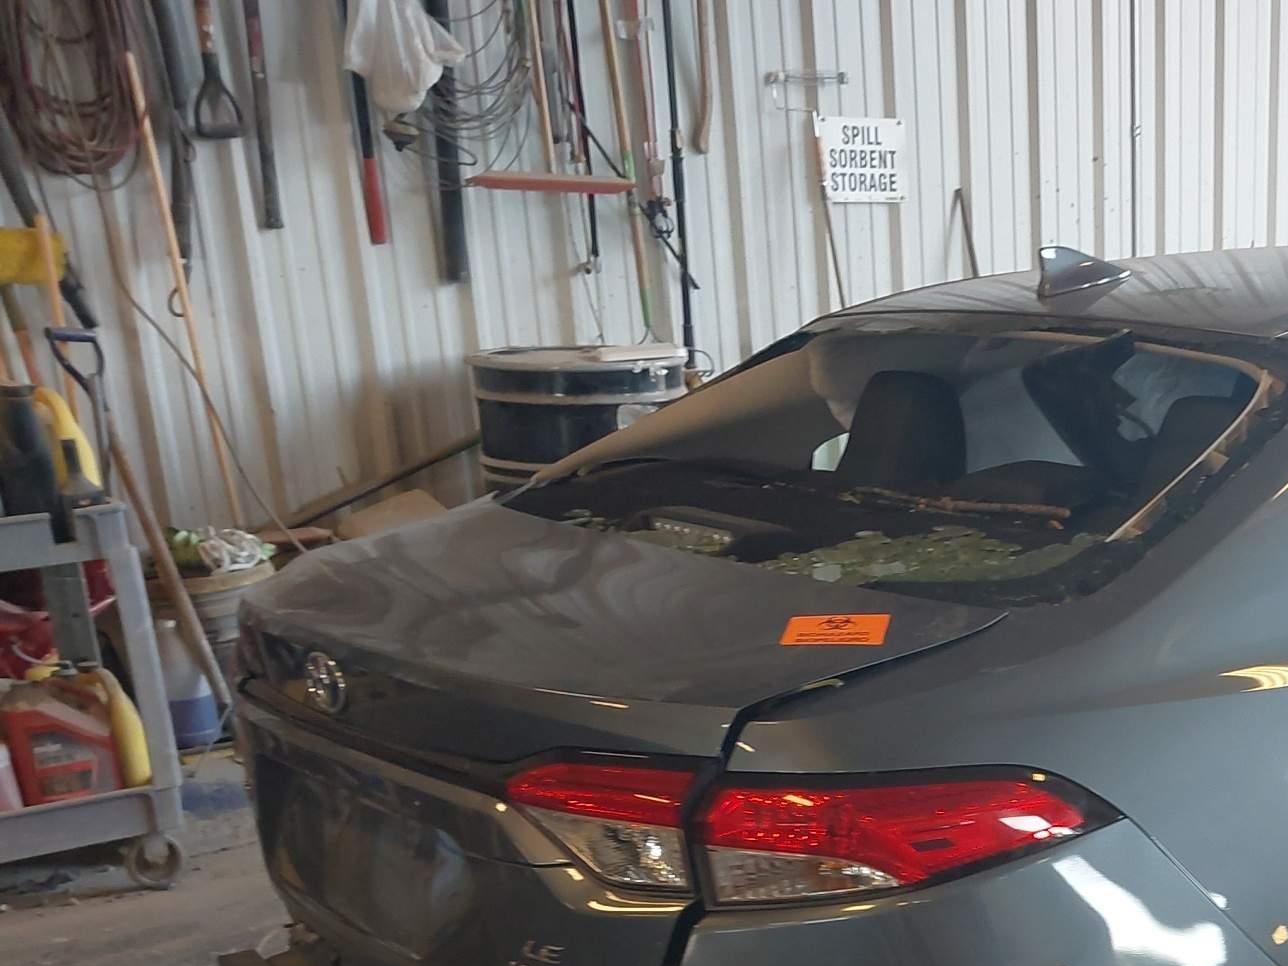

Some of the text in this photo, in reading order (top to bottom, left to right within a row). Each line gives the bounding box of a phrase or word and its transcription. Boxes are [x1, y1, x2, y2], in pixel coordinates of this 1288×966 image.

[841, 125, 882, 146] SPILL
[829, 149, 897, 169] SORBENT
[830, 172, 898, 192] STORAGE
[523, 940, 565, 964] LE
